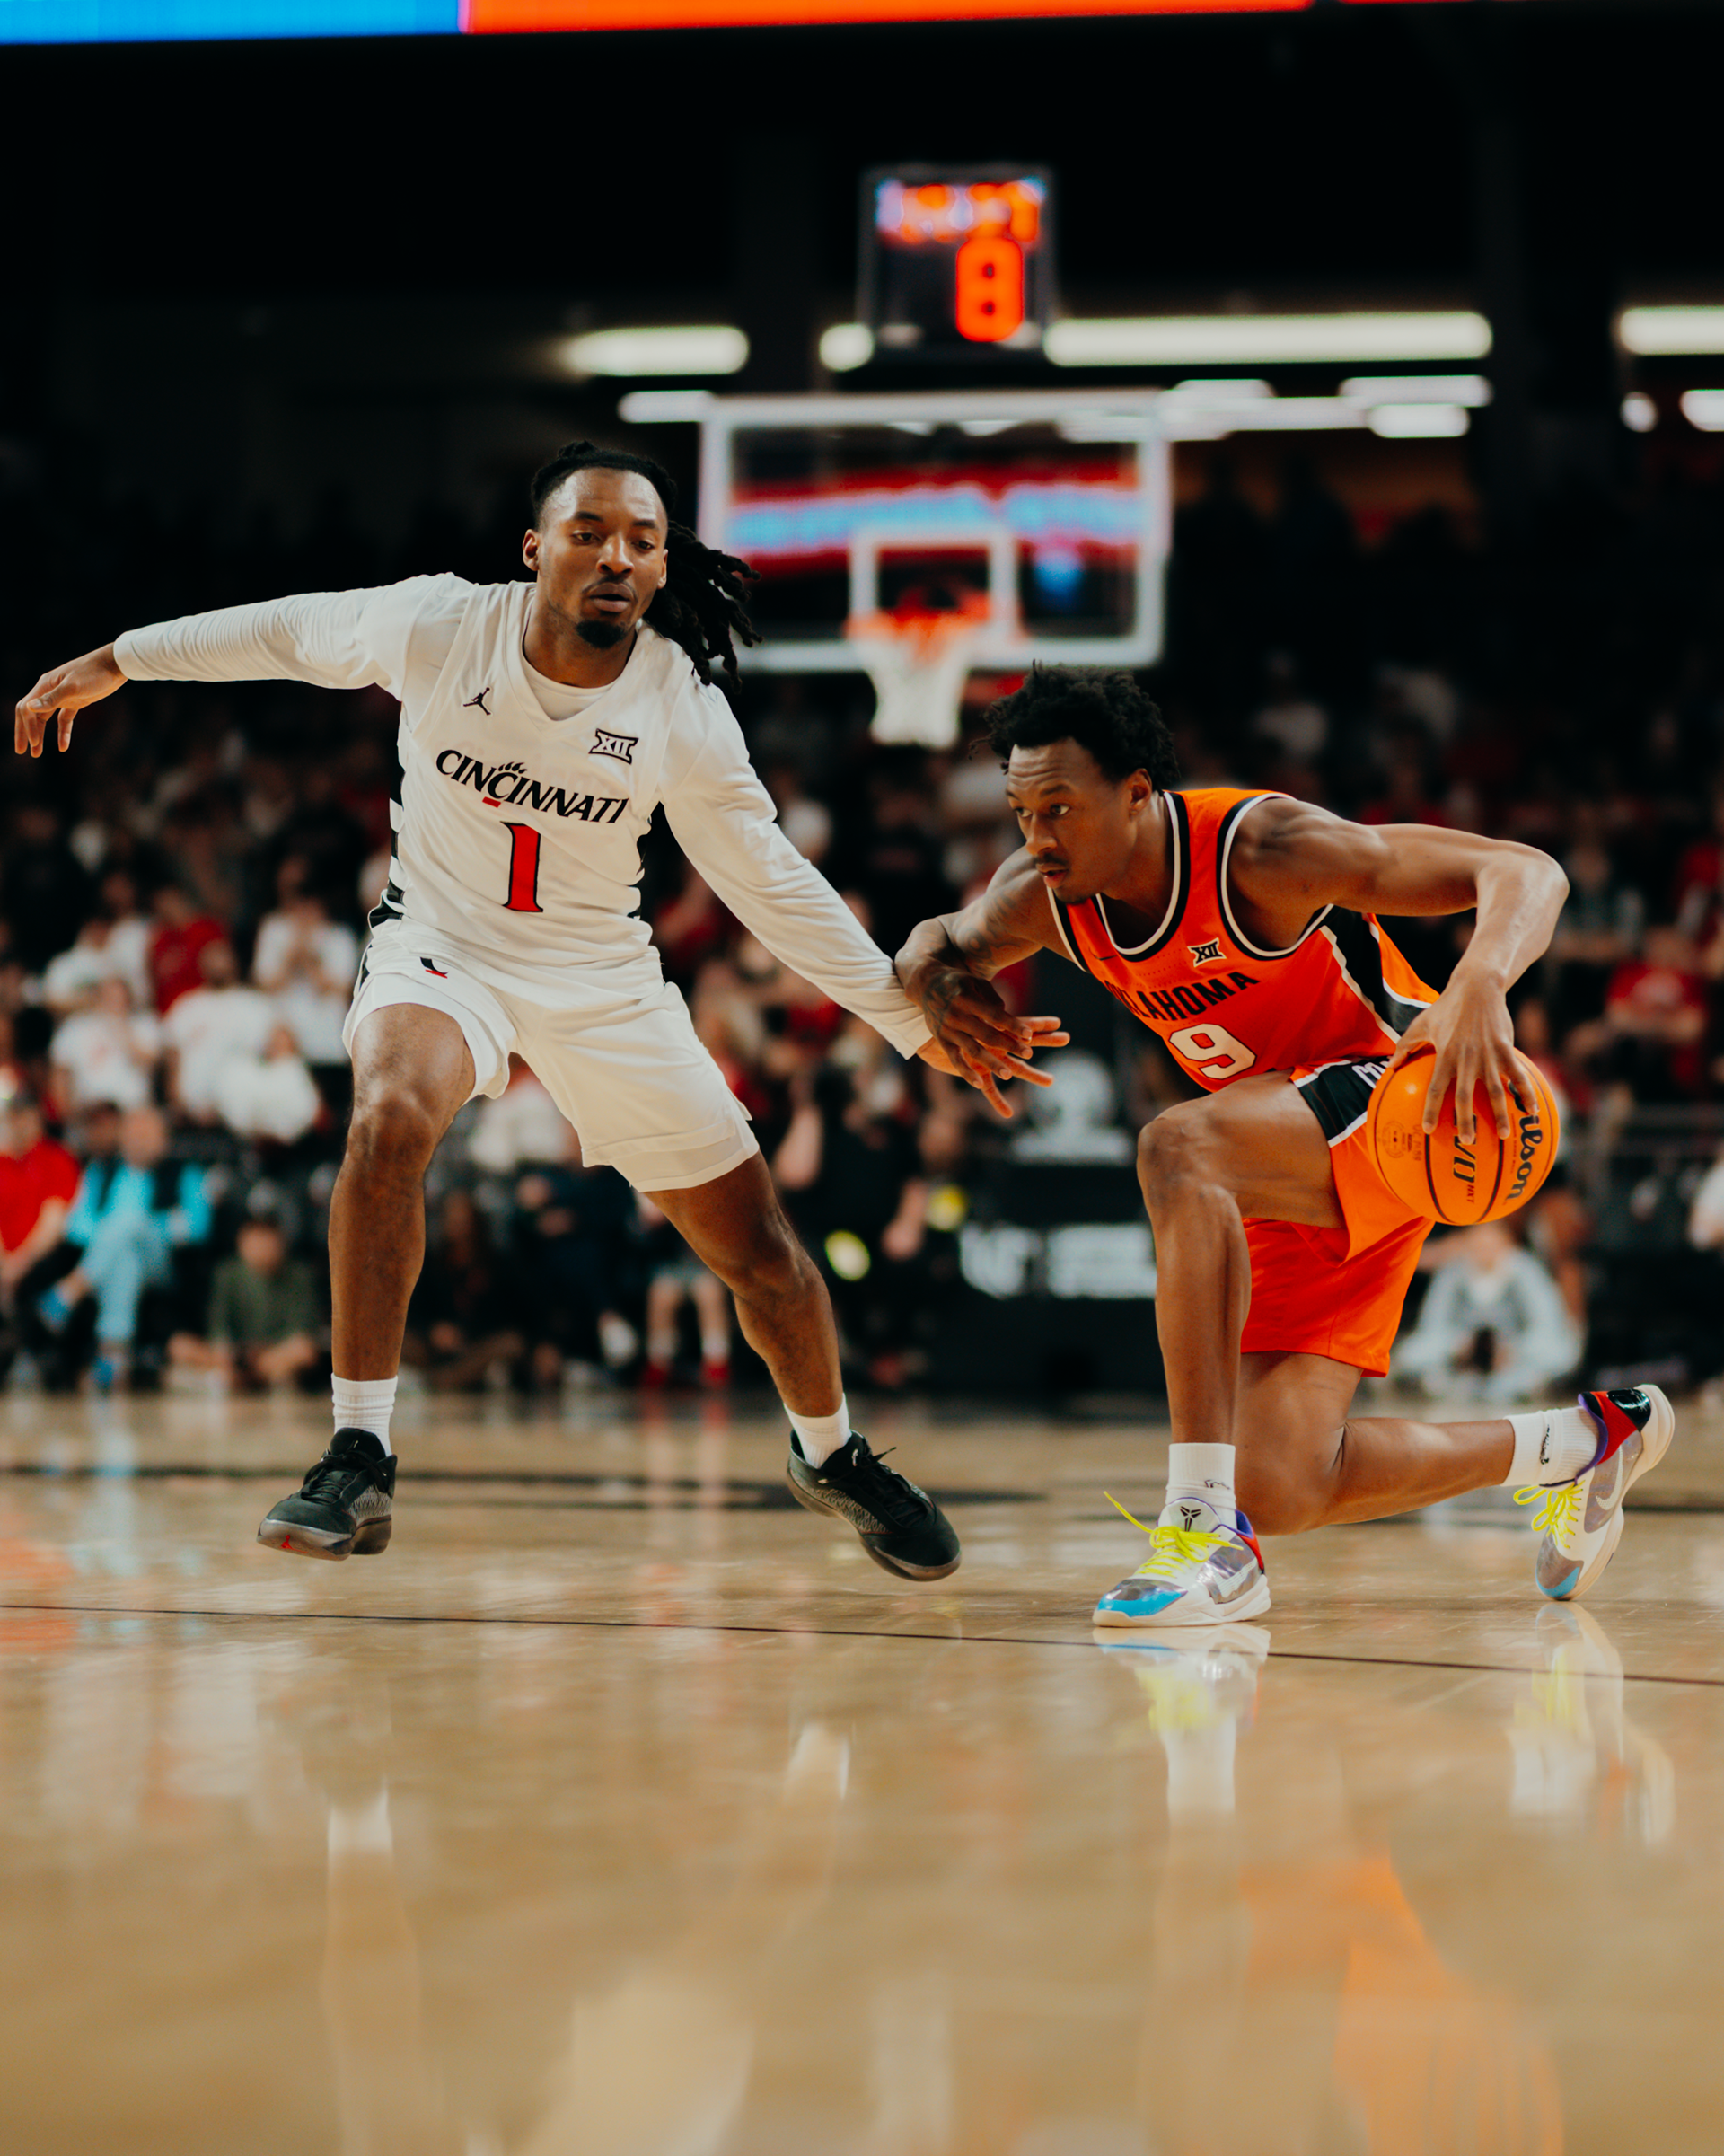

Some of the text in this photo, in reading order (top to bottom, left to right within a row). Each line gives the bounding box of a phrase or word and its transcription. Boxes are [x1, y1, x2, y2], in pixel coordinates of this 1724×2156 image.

[955, 237, 1025, 342] 8
[590, 730, 637, 762] XII
[436, 749, 629, 824] CINCINNATI
[499, 820, 544, 913] 1
[1190, 940, 1225, 964] XII
[1169, 1023, 1257, 1079] 9
